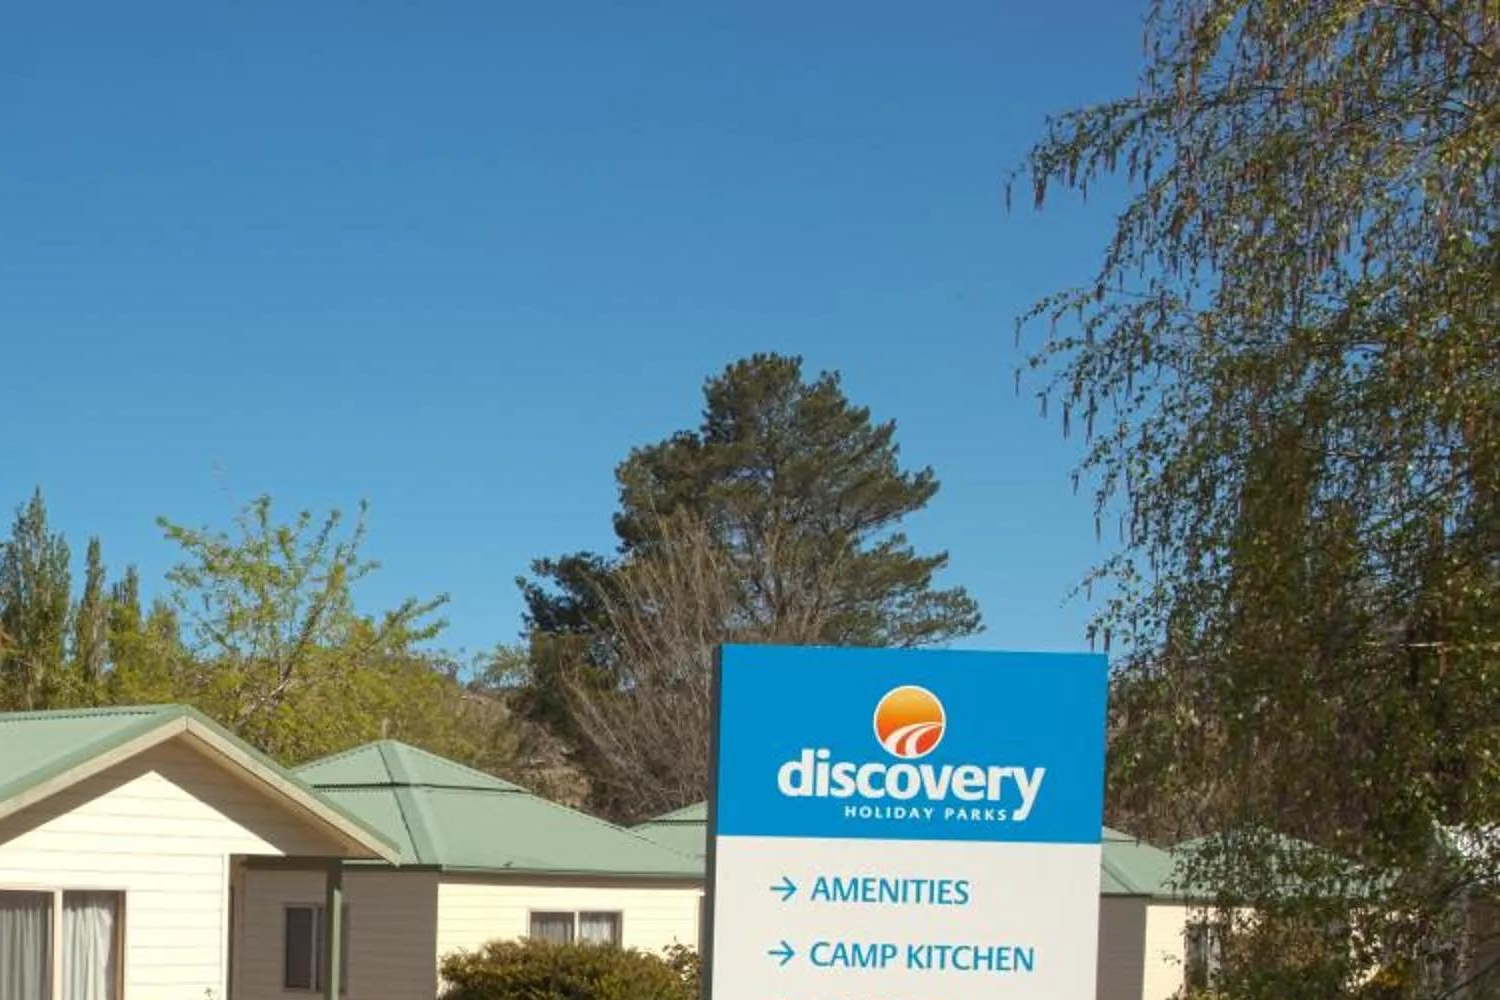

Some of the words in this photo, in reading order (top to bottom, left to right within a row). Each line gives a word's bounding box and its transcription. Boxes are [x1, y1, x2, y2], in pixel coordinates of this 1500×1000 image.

[777, 748, 1045, 822] discovery
[845, 806, 933, 819] HOLIDAY
[945, 807, 1006, 821] PARKS
[811, 875, 969, 906] AMENITIES
[809, 941, 898, 969] CAMP
[906, 943, 1035, 973] KITCHEN
